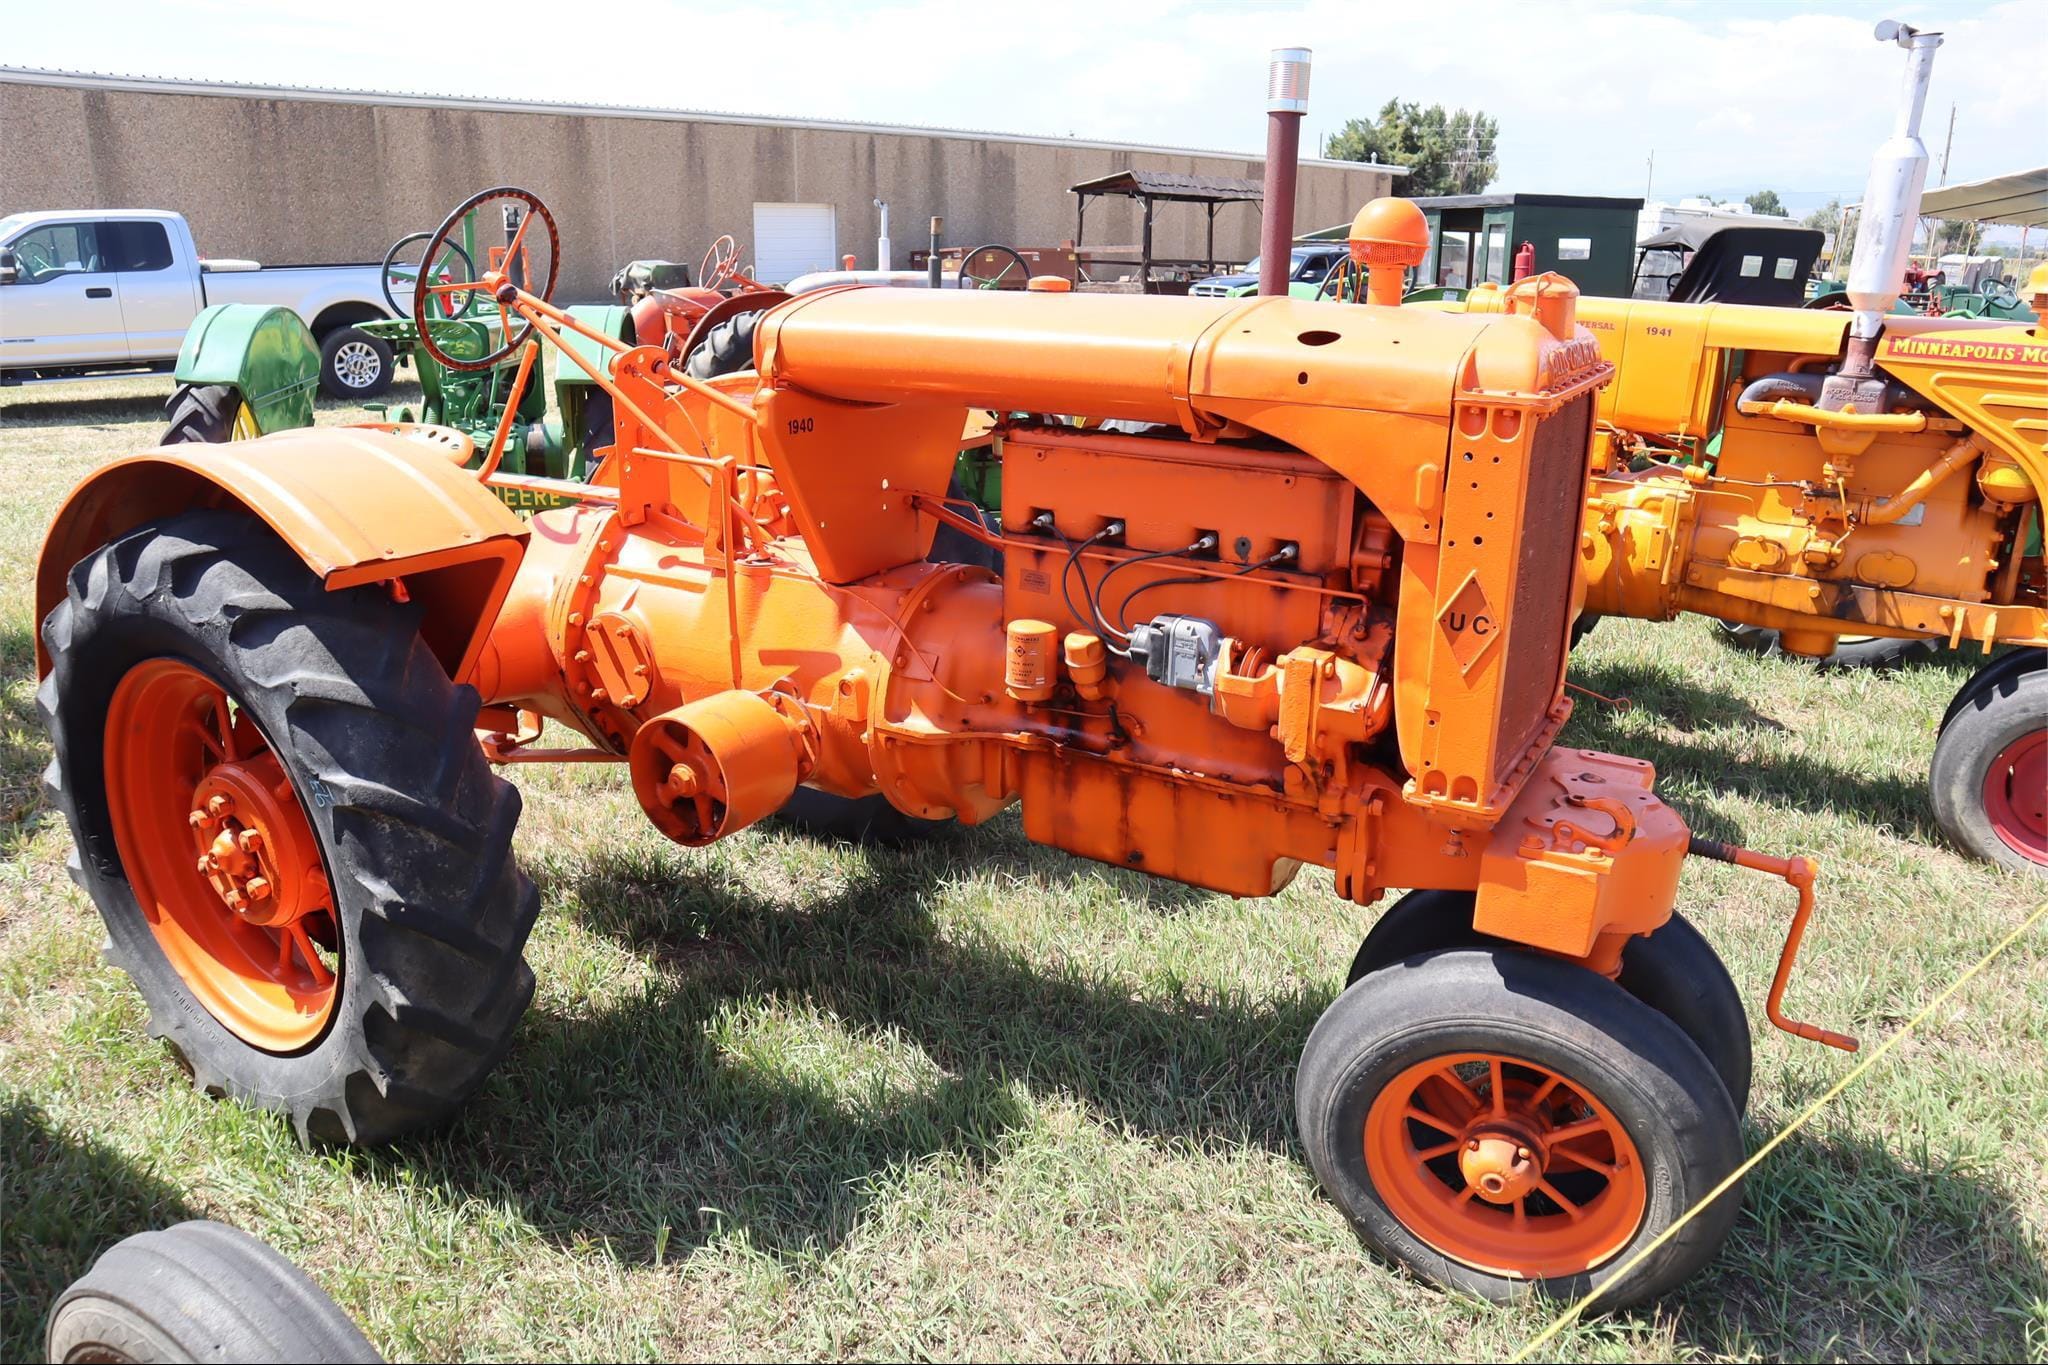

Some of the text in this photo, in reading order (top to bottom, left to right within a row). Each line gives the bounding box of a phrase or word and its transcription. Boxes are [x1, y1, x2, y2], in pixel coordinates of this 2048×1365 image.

[1575, 320, 1616, 331] VERSAL
[1646, 326, 1673, 337] 1941
[788, 417, 814, 435] 1940
